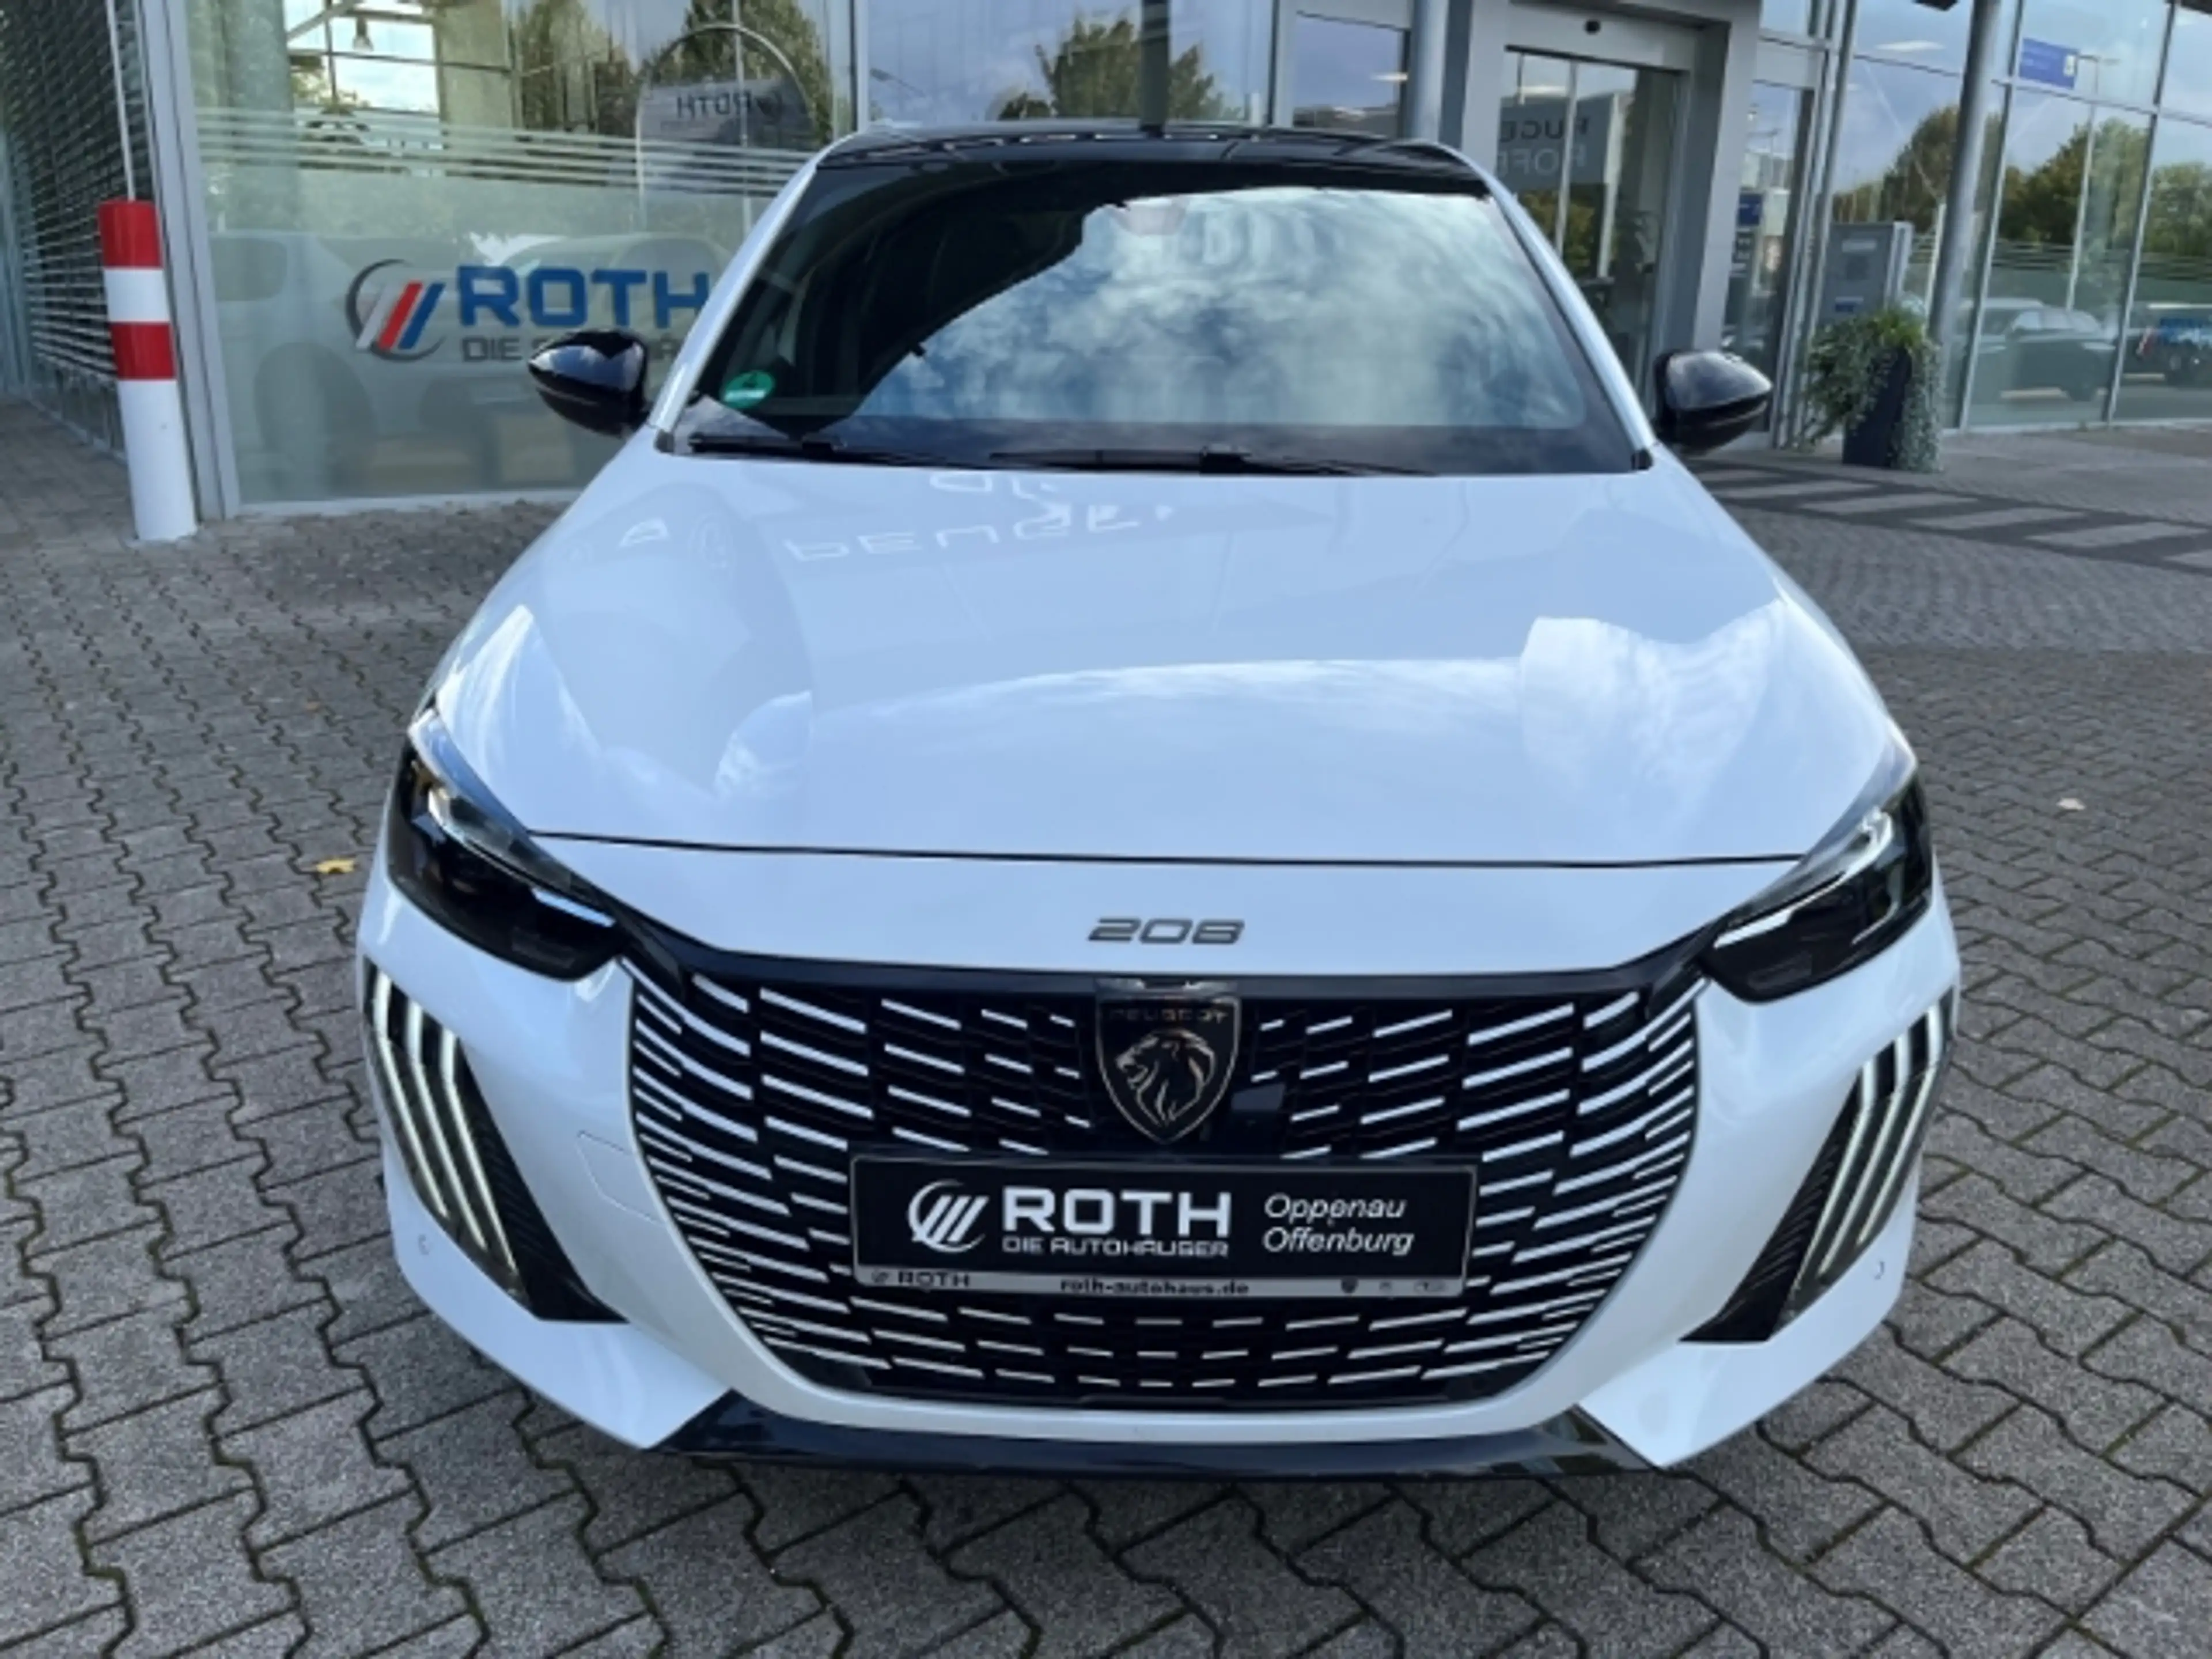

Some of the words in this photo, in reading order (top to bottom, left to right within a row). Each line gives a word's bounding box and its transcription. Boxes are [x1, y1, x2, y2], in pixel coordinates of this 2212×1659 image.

[457, 266, 709, 328] ROTH
[461, 336, 521, 362] DIE
[1088, 918, 1245, 945] 208
[1002, 1185, 1232, 1238] ROTH
[1264, 1193, 1407, 1226] Oppenau
[1002, 1236, 1044, 1253] DIE
[1263, 1226, 1415, 1256] Offenburg
[898, 1271, 970, 1288] ROTH
[1060, 1277, 1249, 1295] roth-autohaus.de
